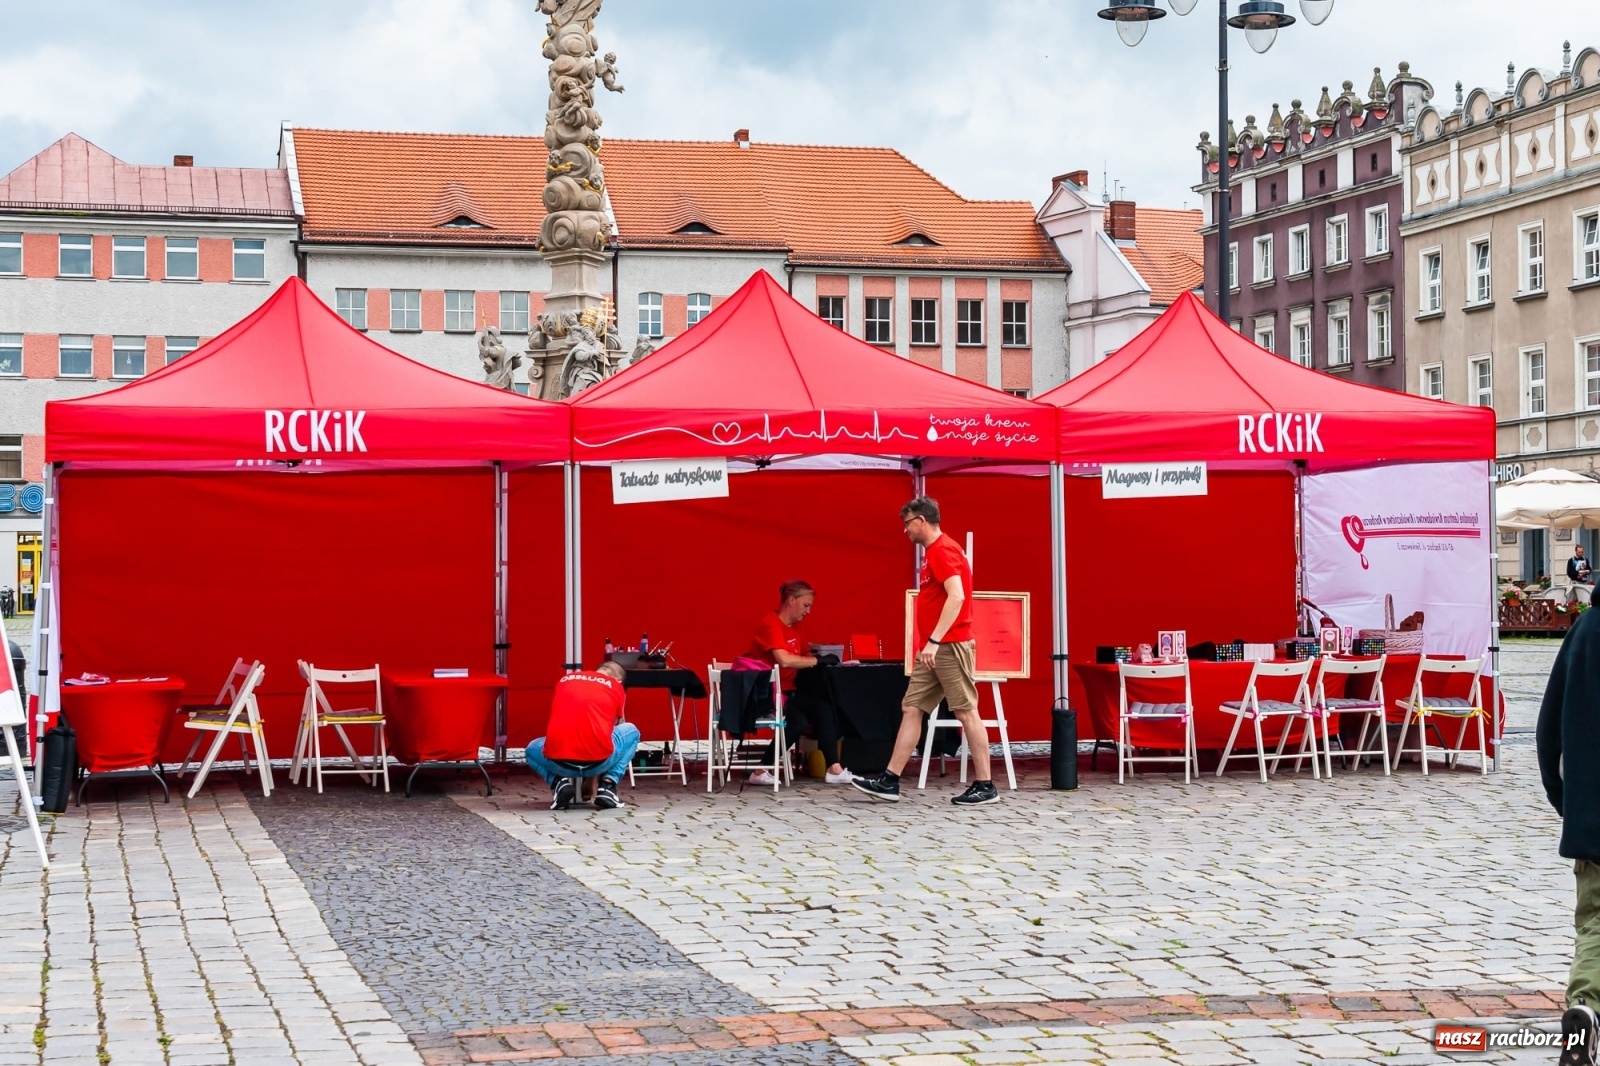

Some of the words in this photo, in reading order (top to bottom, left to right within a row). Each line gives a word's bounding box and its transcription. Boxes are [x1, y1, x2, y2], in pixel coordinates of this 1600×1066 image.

[265, 410, 368, 452] RCKiK
[929, 413, 980, 431] twoja
[984, 413, 1031, 428] krew
[1237, 412, 1325, 453] RCKiK
[941, 431, 990, 446] moje
[620, 470, 660, 488] Tatuaże
[664, 466, 723, 486] natryskowe
[1105, 469, 1152, 488] Magnesy
[1155, 468, 1159, 482] i
